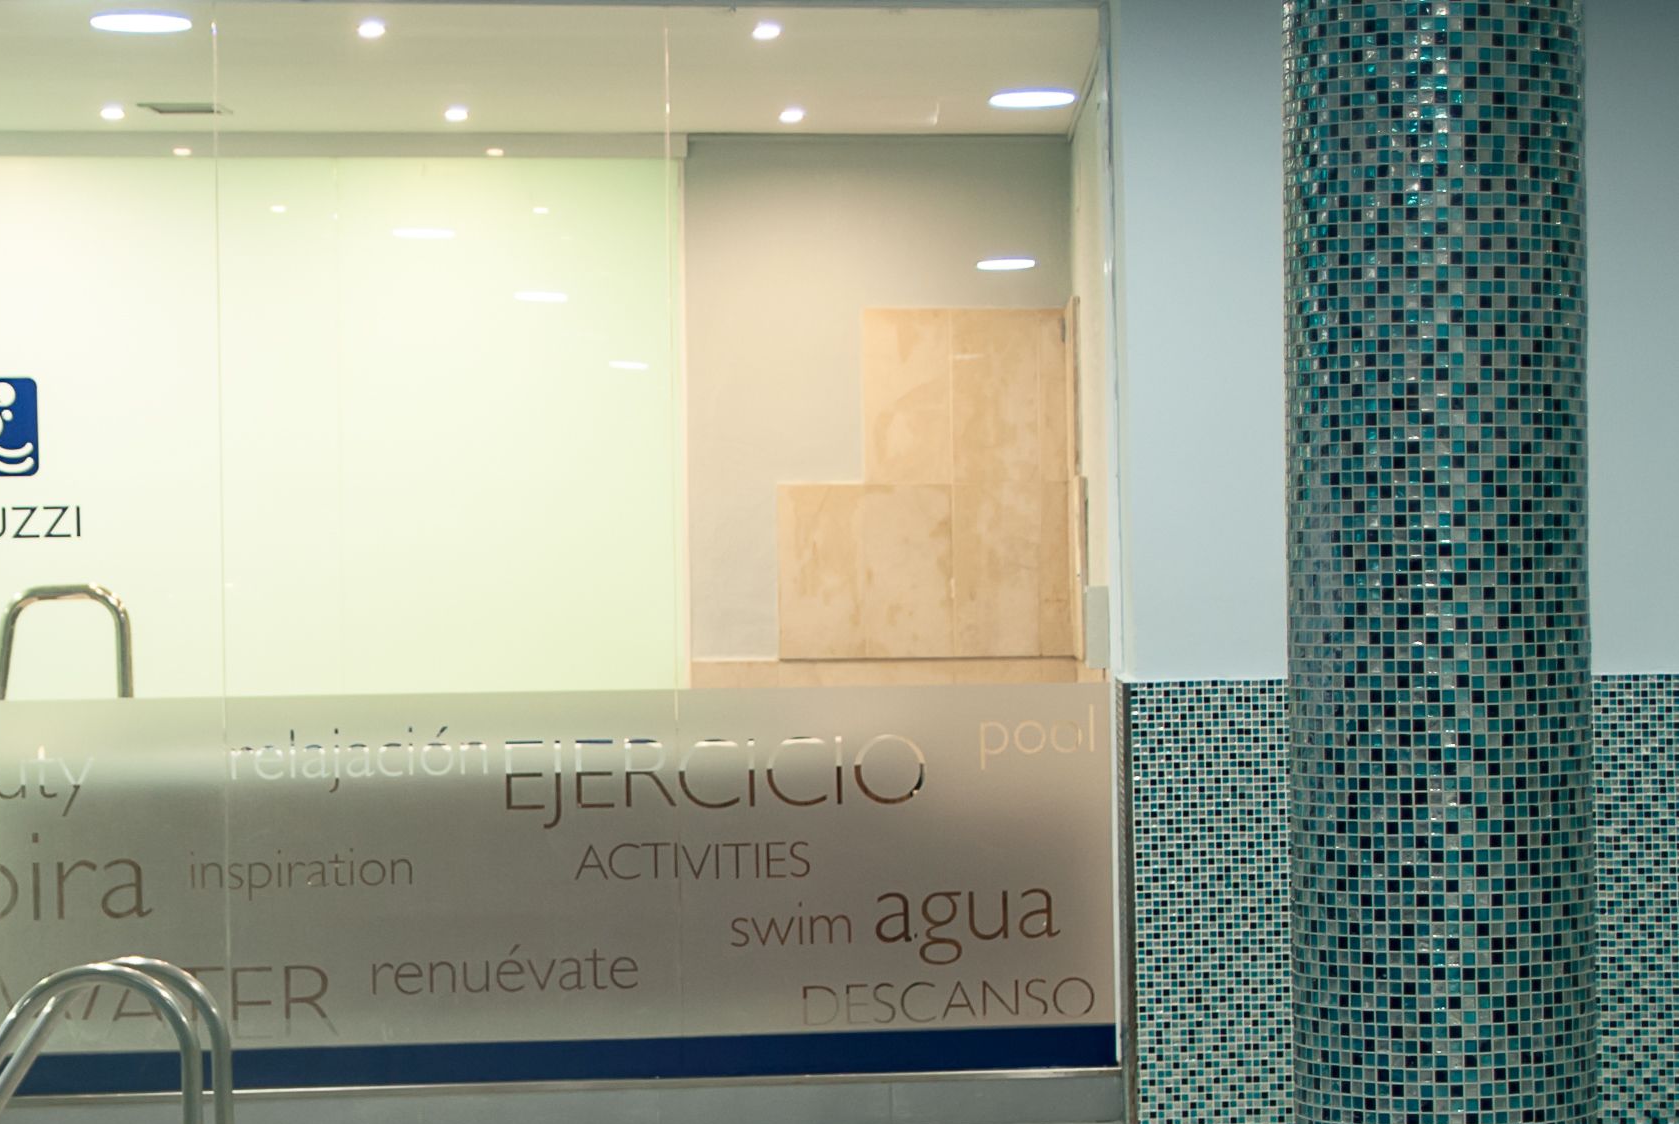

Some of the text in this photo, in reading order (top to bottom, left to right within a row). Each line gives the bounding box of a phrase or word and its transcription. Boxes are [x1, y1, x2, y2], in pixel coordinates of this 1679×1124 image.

[229, 726, 489, 793] relajación
[978, 703, 1096, 770] pool
[504, 732, 927, 829] EJERCICIO
[188, 848, 415, 900] inspiration
[575, 841, 812, 880] ACTIVITIES
[730, 901, 853, 948] swim
[875, 887, 1061, 964] agua
[371, 944, 640, 996] renuévate
[802, 976, 1096, 1027] DESCANSO
